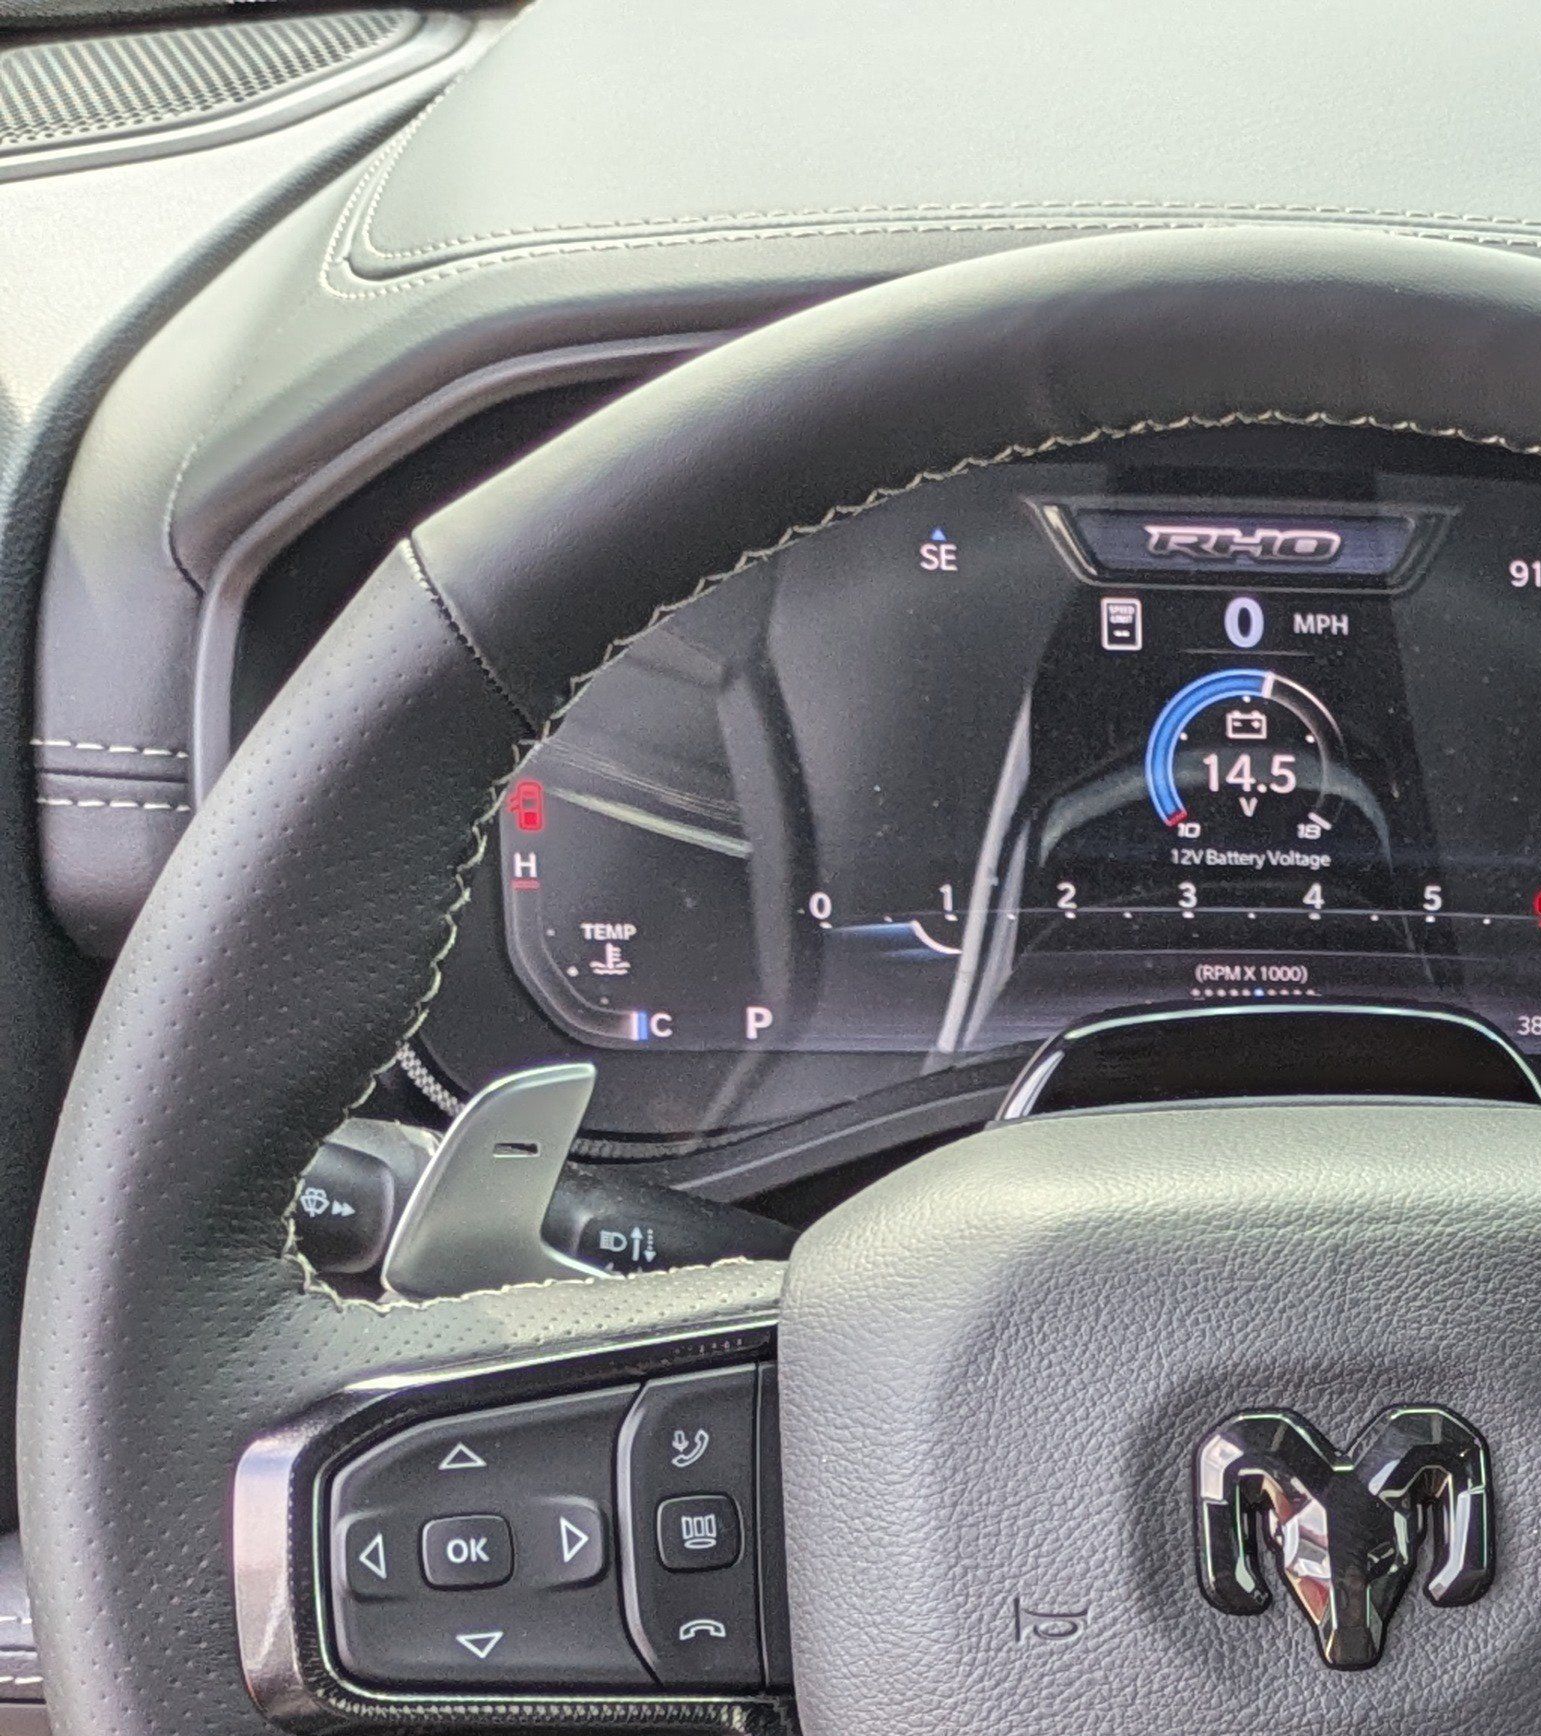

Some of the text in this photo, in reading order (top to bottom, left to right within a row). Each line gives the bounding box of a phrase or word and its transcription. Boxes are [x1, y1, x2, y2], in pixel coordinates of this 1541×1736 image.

[919, 543, 958, 572] SE
[1144, 524, 1342, 562] RHO
[1223, 596, 1265, 648] 0
[1293, 613, 1350, 636] MPH
[1202, 753, 1297, 794] 14.5
[513, 853, 538, 878] H
[1170, 849, 1332, 870] 12V Battery Voltage
[1056, 881, 1077, 910] 2
[1178, 881, 1198, 909] 3
[1302, 883, 1325, 910] 4
[1423, 885, 1443, 910] 5
[581, 923, 637, 942] TEMP
[648, 1012, 673, 1039] C
[746, 1007, 773, 1039] P
[446, 1536, 490, 1565] OK
